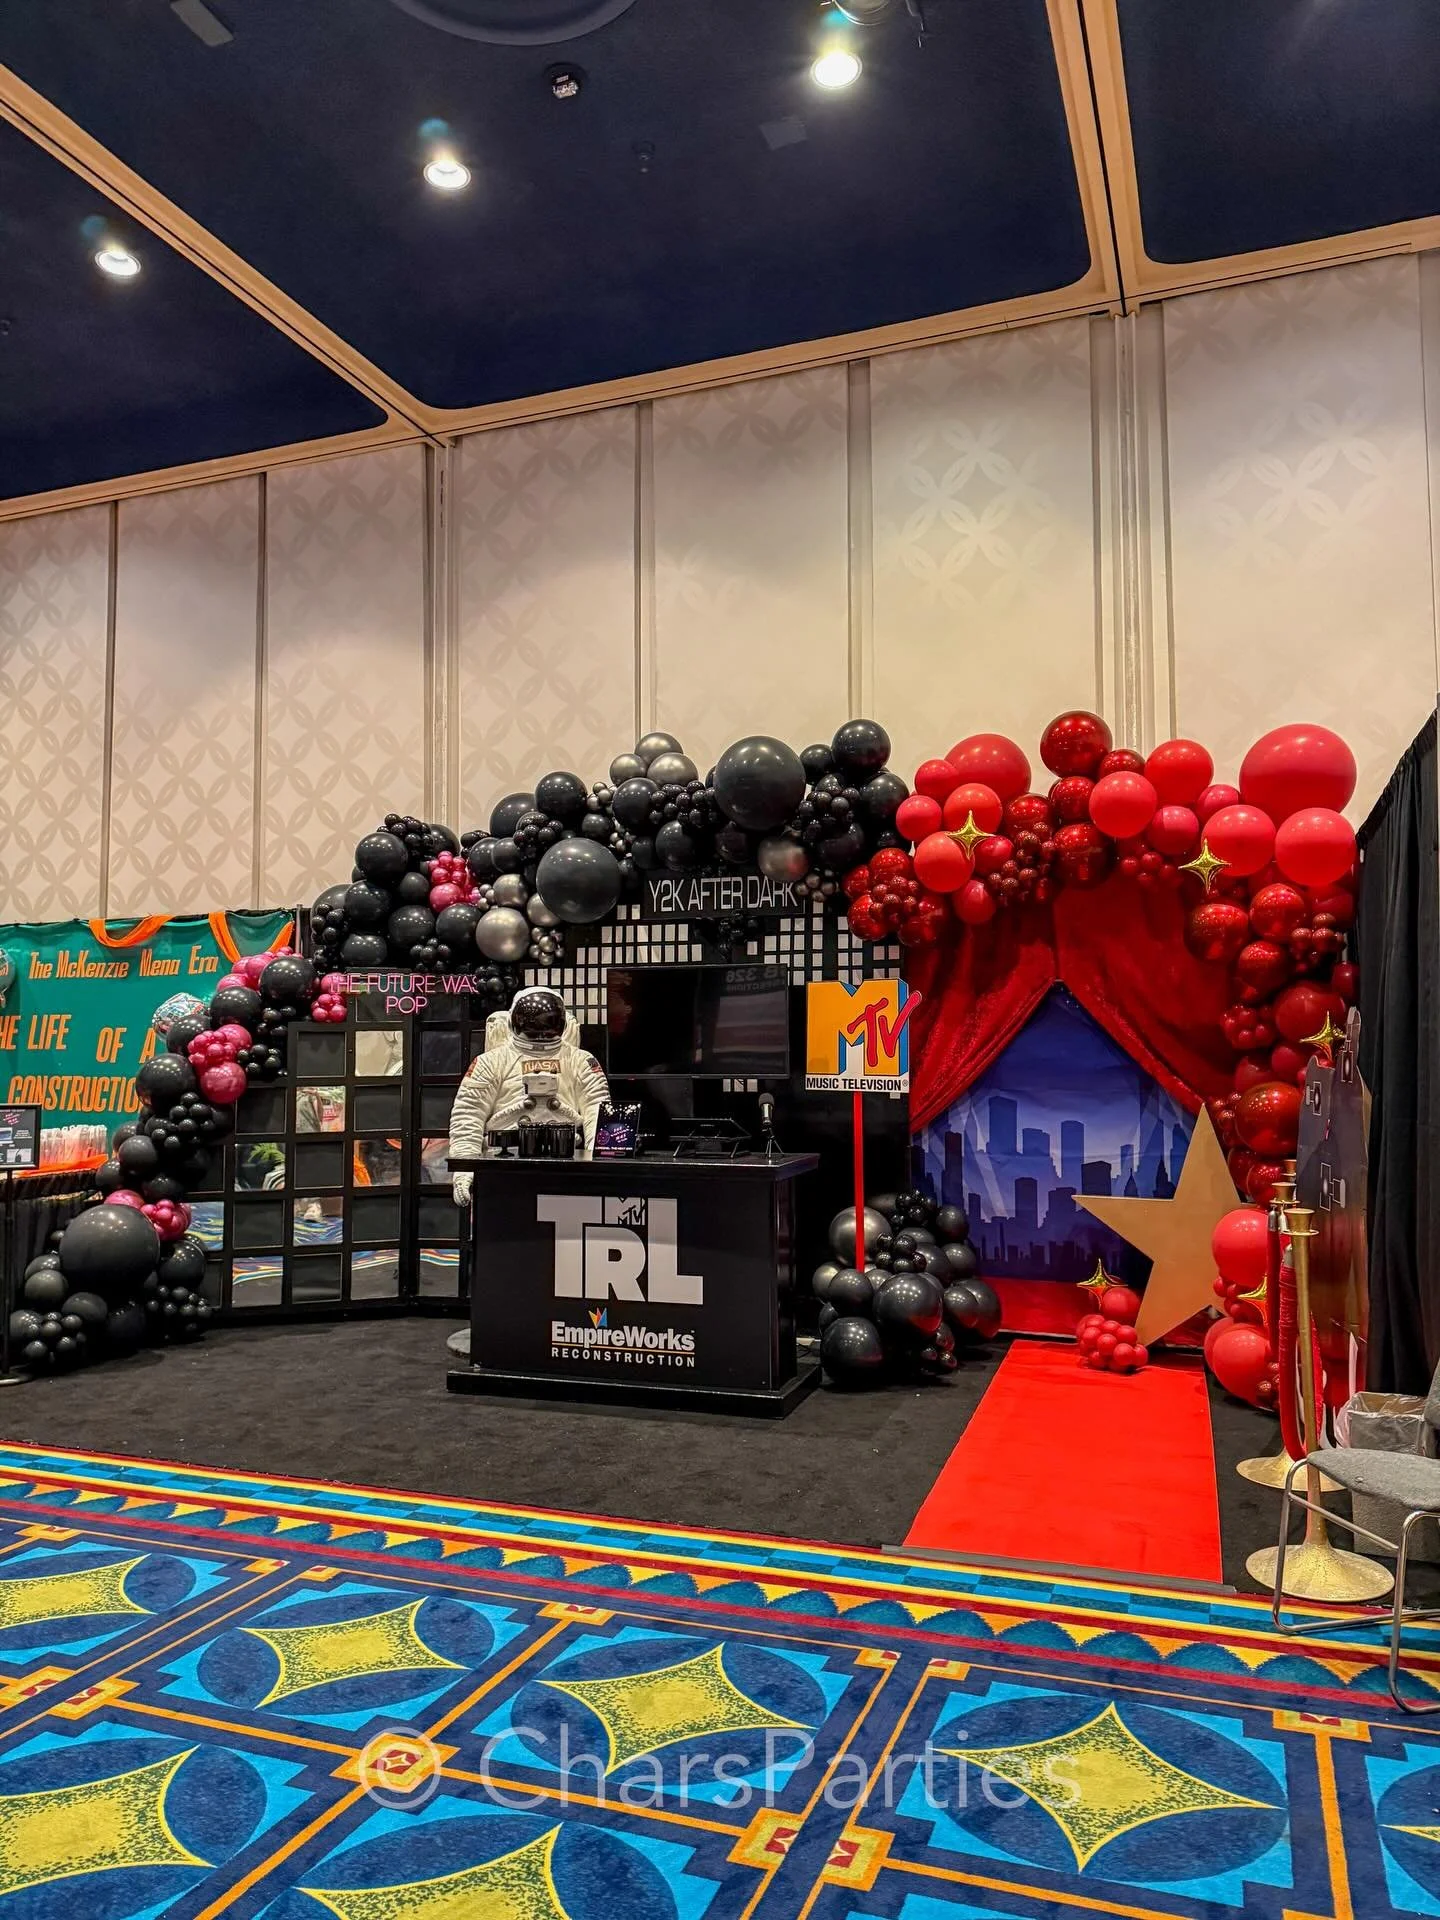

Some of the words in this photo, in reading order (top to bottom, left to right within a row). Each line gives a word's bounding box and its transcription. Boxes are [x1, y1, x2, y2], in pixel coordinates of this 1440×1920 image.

[649, 878, 685, 912] Y2K
[688, 876, 743, 911] AFTER
[747, 875, 798, 908] DARK
[29, 951, 52, 979] The
[56, 949, 129, 978] McKenzie
[188, 945, 219, 975] Era
[328, 973, 361, 993] THE
[367, 974, 436, 993] FUTURE
[386, 996, 427, 1014] POP
[0, 1015, 21, 1050] HE
[27, 1014, 72, 1050] LIFE
[96, 1027, 127, 1063] OF
[139, 1027, 156, 1063] A
[806, 978, 922, 1076] MTV
[524, 1060, 559, 1073] NASA
[7, 1075, 143, 1113] CONSTRUCTIO
[806, 1078, 839, 1089] MUSIC
[842, 1079, 901, 1091] TELEVISION
[605, 1196, 646, 1226] MTV
[537, 1194, 703, 1304] TRL
[551, 1320, 695, 1351] EmpireWorks
[551, 1347, 695, 1368] RECONSTRUCTION
